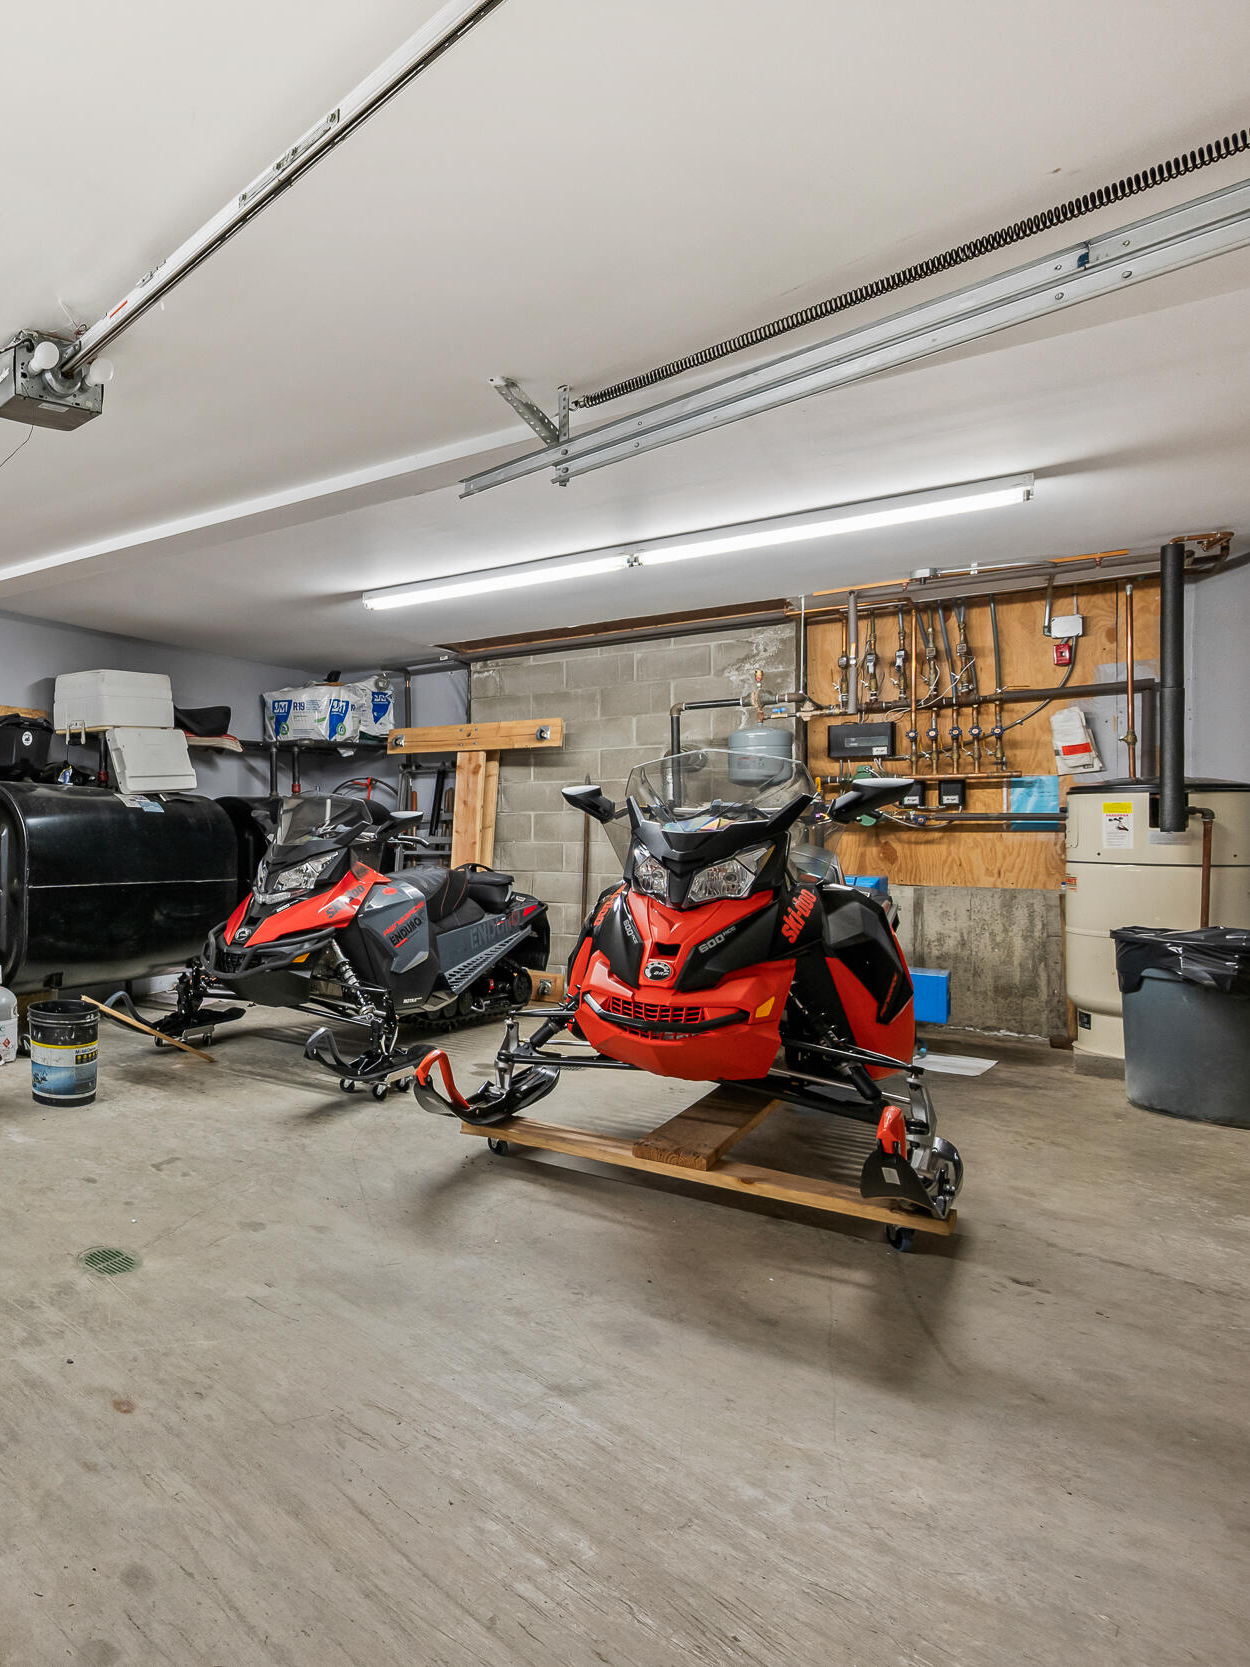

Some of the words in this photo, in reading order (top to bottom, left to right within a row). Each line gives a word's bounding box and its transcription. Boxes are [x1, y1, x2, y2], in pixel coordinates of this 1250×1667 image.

[293, 701, 306, 711] R19
[781, 888, 817, 944] ski-doo
[390, 917, 423, 946] ENDURO
